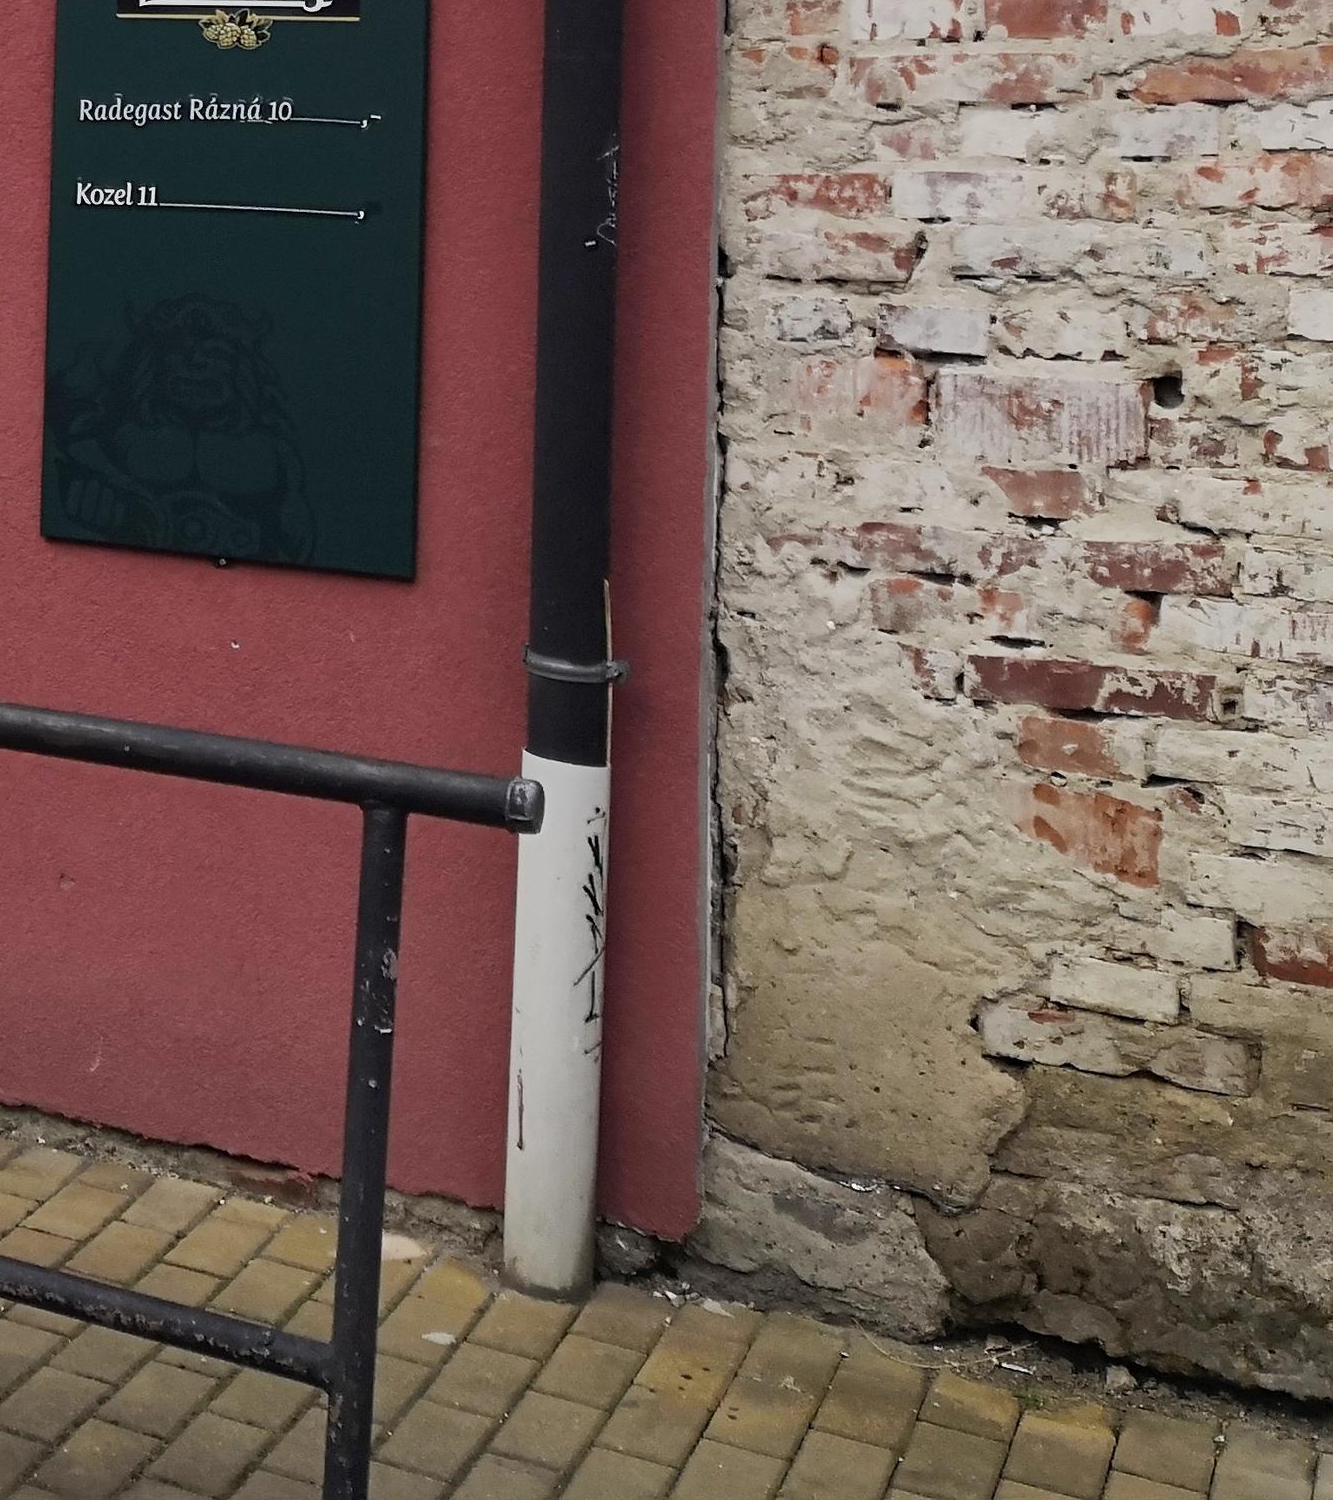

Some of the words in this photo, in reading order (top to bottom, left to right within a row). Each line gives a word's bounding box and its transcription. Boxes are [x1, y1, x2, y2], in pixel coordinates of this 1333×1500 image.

[79, 98, 182, 126] Radegast
[189, 98, 263, 122] Rázná
[269, 100, 293, 121] 10
[76, 182, 134, 206] Kozel
[137, 186, 158, 206] 11
